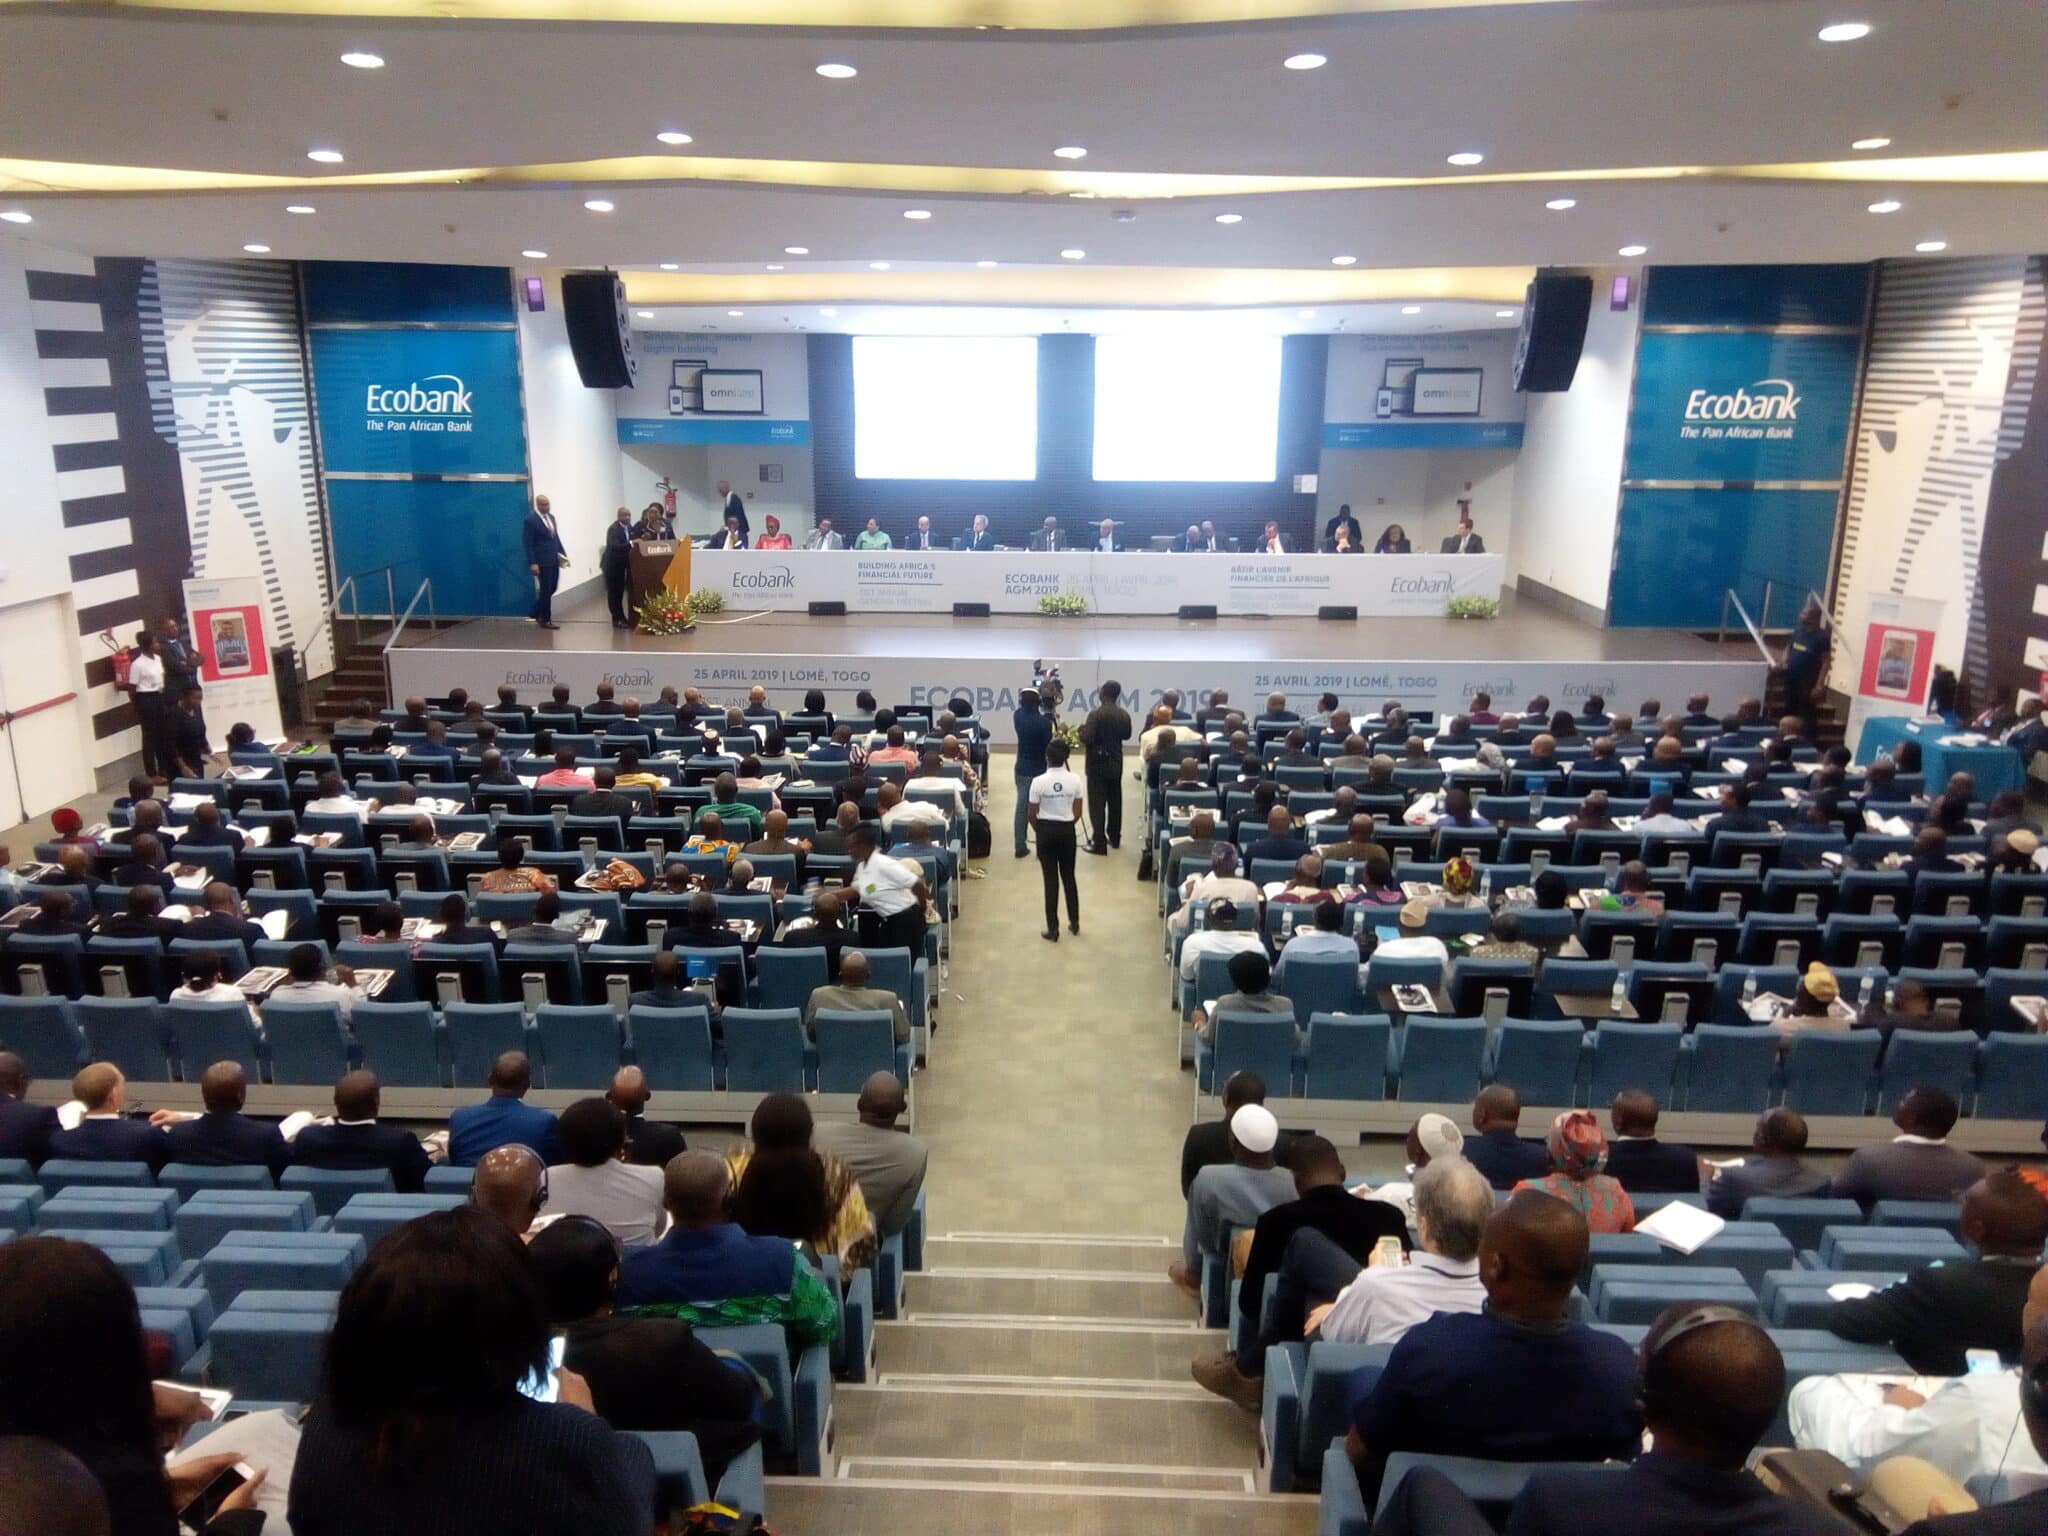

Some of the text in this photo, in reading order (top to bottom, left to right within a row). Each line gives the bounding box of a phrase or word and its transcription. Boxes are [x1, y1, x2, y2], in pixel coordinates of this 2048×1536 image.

[366, 374, 473, 413] Ecobank
[1684, 379, 1802, 420] Ecobank
[366, 420, 472, 433] The Pan African Bank
[1680, 426, 1794, 439] The Pan African Bank
[857, 561, 897, 570] BUILDING
[732, 565, 796, 589] Ecobank
[1005, 574, 1060, 584] ECOBANK
[1391, 570, 1456, 593] Ecobank
[1005, 585, 1032, 595] AGM
[1035, 585, 1060, 595] 2019
[505, 666, 559, 686] Ecobank
[693, 668, 709, 680] 25
[711, 669, 748, 681] APRIL
[751, 669, 779, 681] 2019
[832, 671, 871, 682] TOGO
[1255, 675, 1270, 687] 25
[1273, 675, 1310, 687] AVRIL
[1313, 675, 1342, 687] 2019
[1399, 676, 1438, 688] TOGO
[910, 686, 1024, 712] ECOBA
